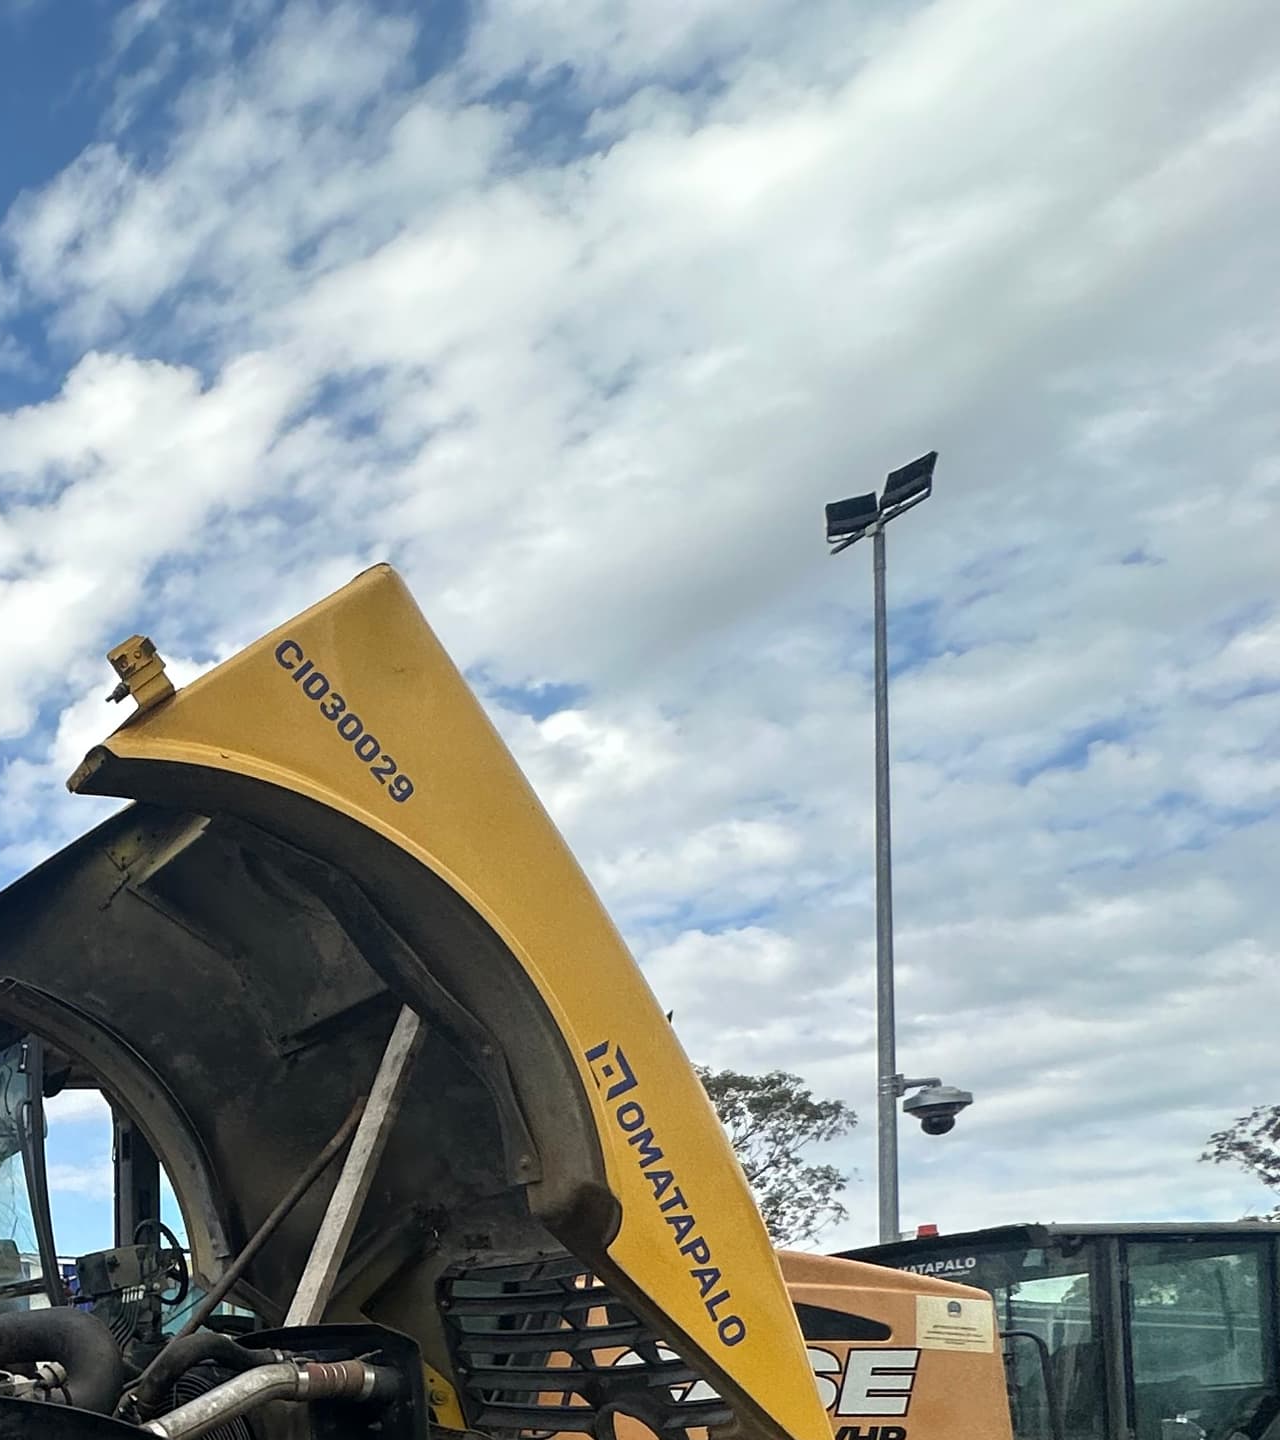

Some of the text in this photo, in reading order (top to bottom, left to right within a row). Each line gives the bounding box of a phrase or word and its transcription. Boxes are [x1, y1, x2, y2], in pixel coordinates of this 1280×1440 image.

[275, 640, 414, 803] CI030029
[616, 1101, 746, 1347] OMATAPALO
[900, 1257, 976, 1274] ATAPALO
